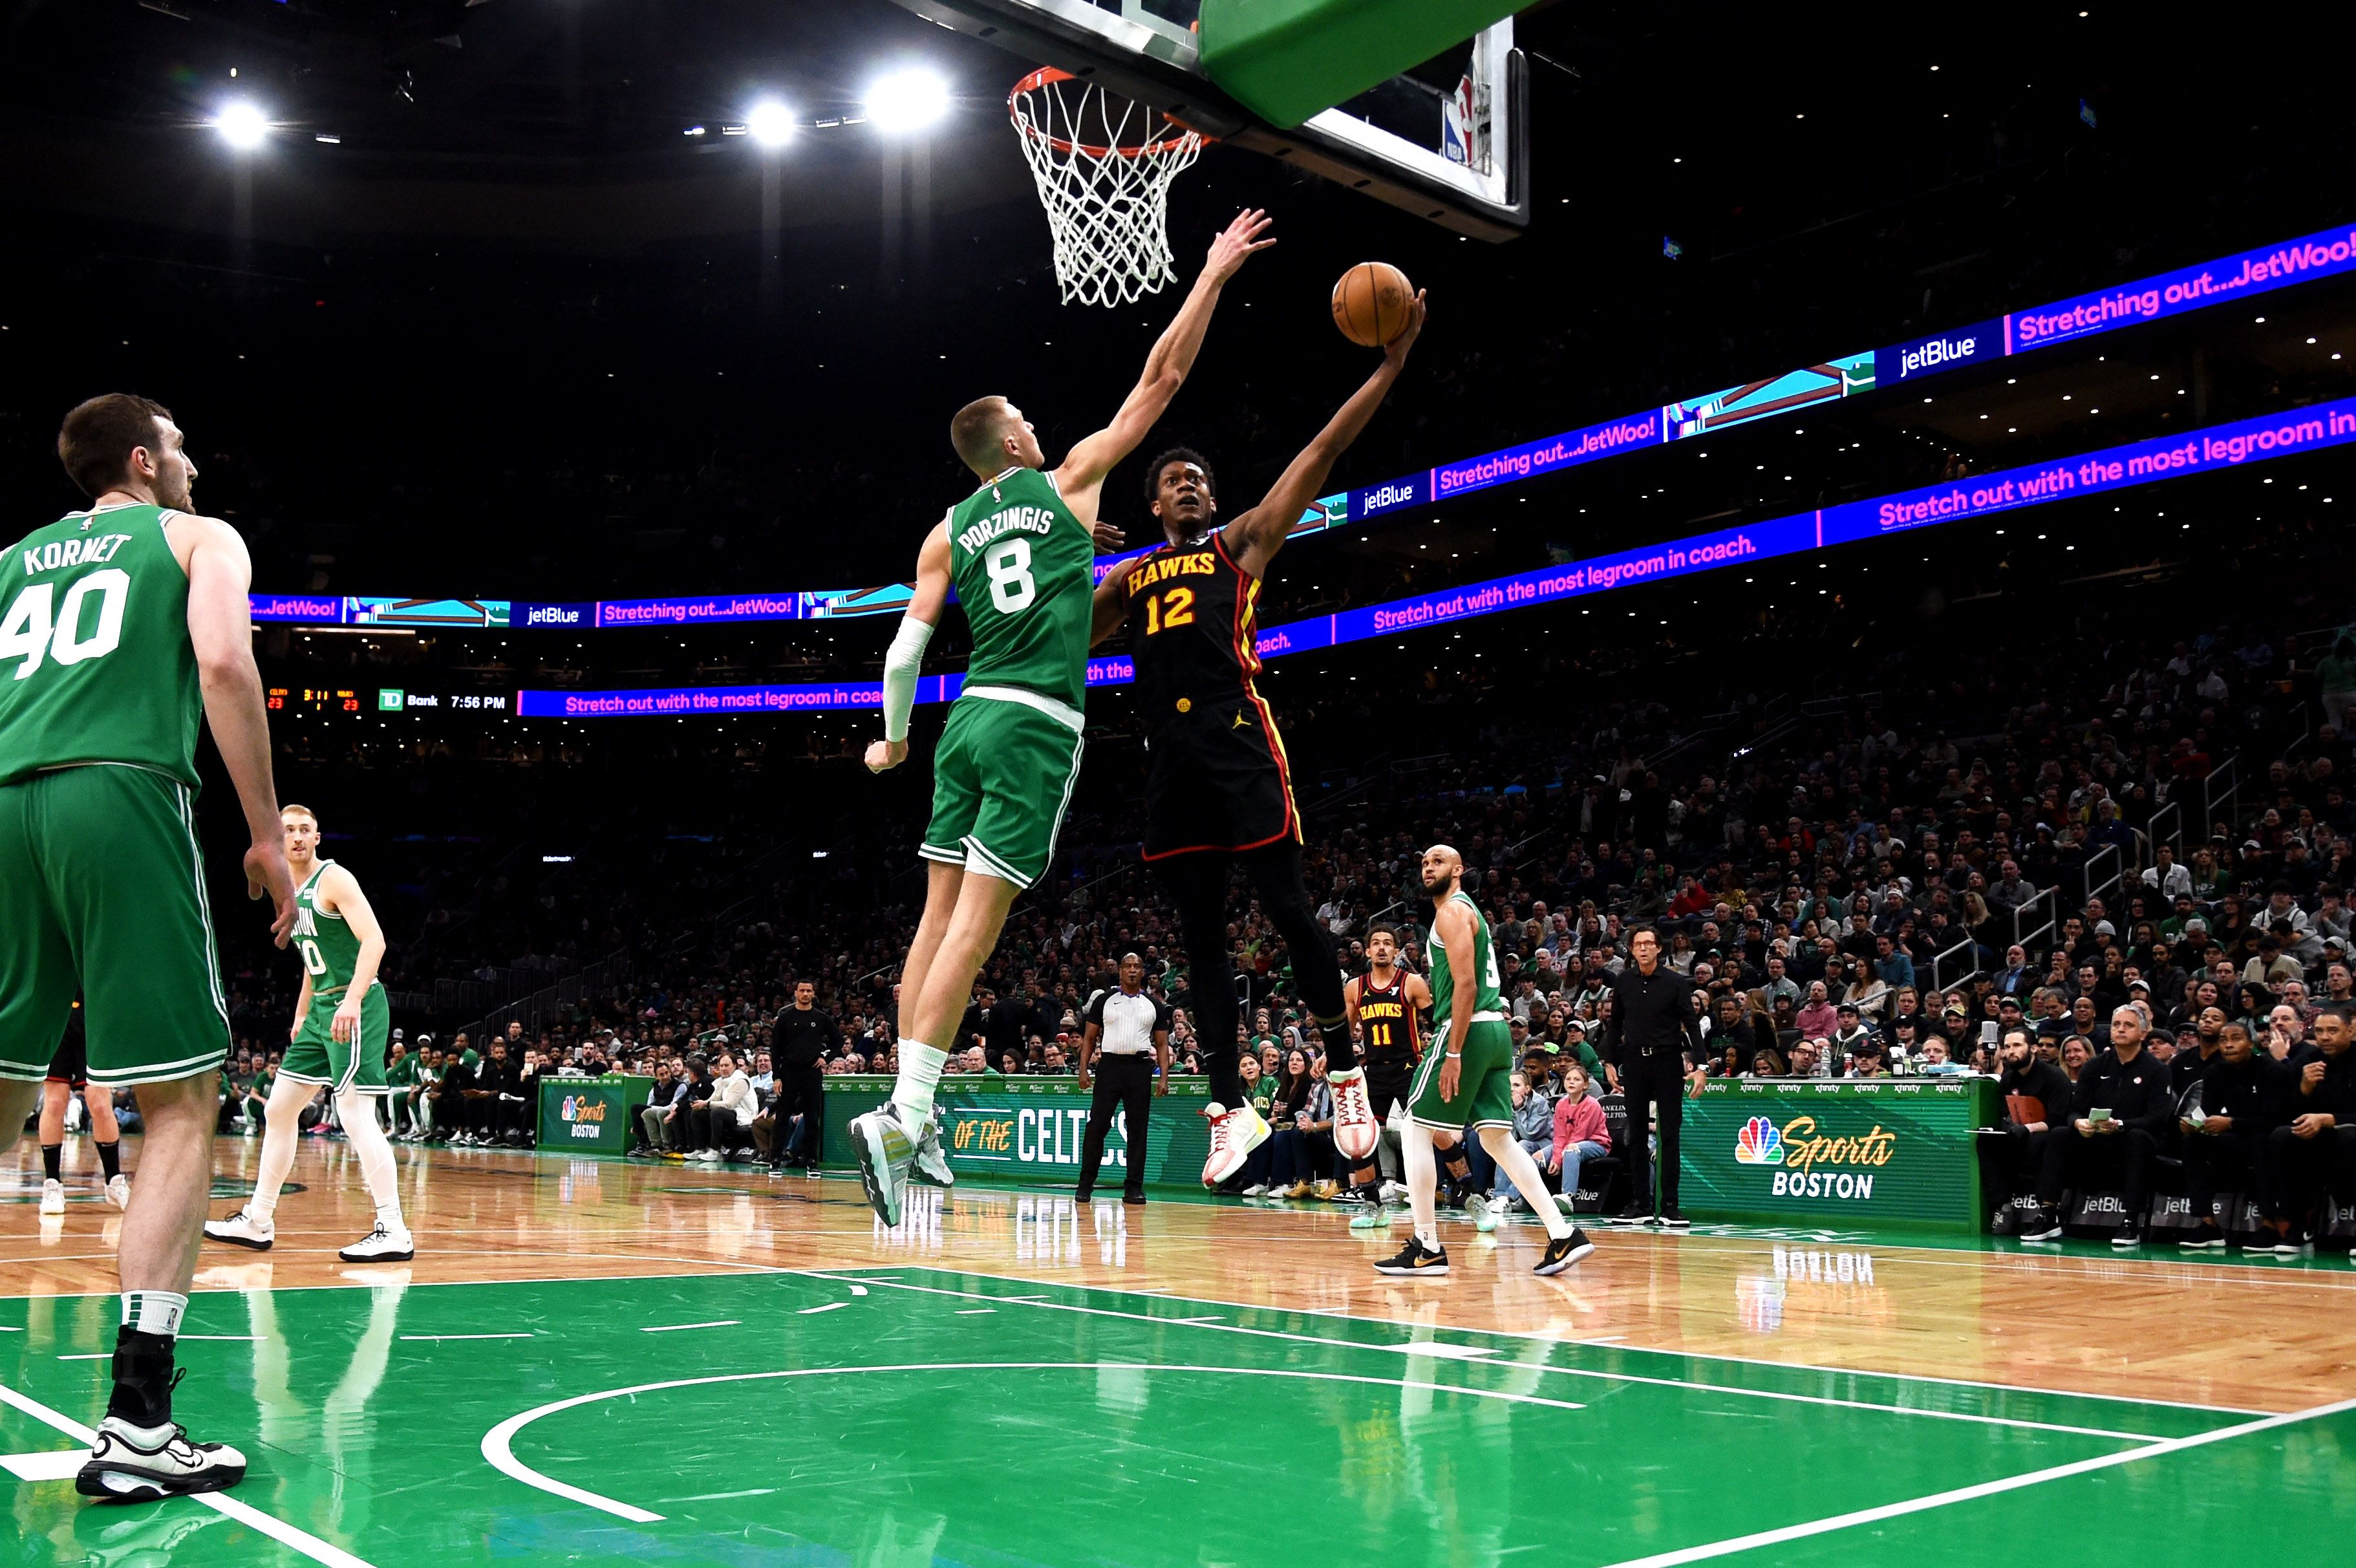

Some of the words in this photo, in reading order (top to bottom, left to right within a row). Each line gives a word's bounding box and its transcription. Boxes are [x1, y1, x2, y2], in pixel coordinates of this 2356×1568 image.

[1447, 142, 1462, 160] NBA
[2019, 290, 2160, 341] Stretching
[2164, 231, 2356, 303] out...JetWoo!
[1900, 338, 1975, 378] jetBlue
[1440, 454, 1530, 490] Stretching
[1533, 416, 1655, 466] out...JetWoo!
[1879, 489, 1968, 526] Stretch
[1971, 480, 2015, 508] out
[2018, 467, 2075, 498] with
[2078, 460, 2123, 486] the
[2128, 442, 2199, 477] most
[2203, 420, 2324, 462] legroom
[2329, 411, 2356, 436] in
[1364, 486, 1413, 515] jetBlue
[958, 507, 1054, 555] PORZINGIS
[24, 534, 132, 575] KORNET
[985, 537, 1036, 614] 8
[1128, 552, 1215, 598] HAWKS
[1374, 601, 1433, 629] Stretch
[1435, 595, 1464, 617] out
[1466, 586, 1504, 610] with
[1506, 581, 1536, 602] the
[1539, 570, 1585, 596] most
[1587, 556, 1665, 588] legroom
[1668, 549, 1686, 570] in
[1689, 534, 1757, 564] coach.
[250, 599, 336, 616] ...JetWoo!
[528, 607, 579, 626] jetBlue
[605, 603, 686, 621] Stretching
[688, 597, 792, 617] out...JetWoo!
[1146, 586, 1195, 636] 12
[0, 568, 131, 680] 40
[1106, 662, 1133, 679] the
[1255, 632, 1291, 654] oach.
[268, 697, 283, 709] 23
[343, 699, 359, 711] 23
[381, 692, 401, 707] TD
[407, 694, 438, 707] Bank
[451, 696, 480, 709] 7:56
[484, 696, 506, 709] PM
[565, 696, 625, 712] Stretch
[626, 696, 654, 711] out
[656, 694, 691, 709] with
[692, 693, 720, 708] the
[722, 692, 762, 707] most
[764, 691, 831, 709] legroom
[833, 689, 848, 704] in
[850, 691, 883, 703] coa
[1358, 1002, 1402, 1020] HAWKS
[1371, 1024, 1391, 1046] 11
[576, 1095, 606, 1122] Sports
[571, 1124, 600, 1139] BOSTON
[954, 1119, 978, 1149] OF
[980, 1119, 1014, 1151] THE
[1018, 1108, 1128, 1166] CELT
[1781, 1116, 1896, 1177] Sports
[1772, 1172, 1874, 1199] BOSTON
